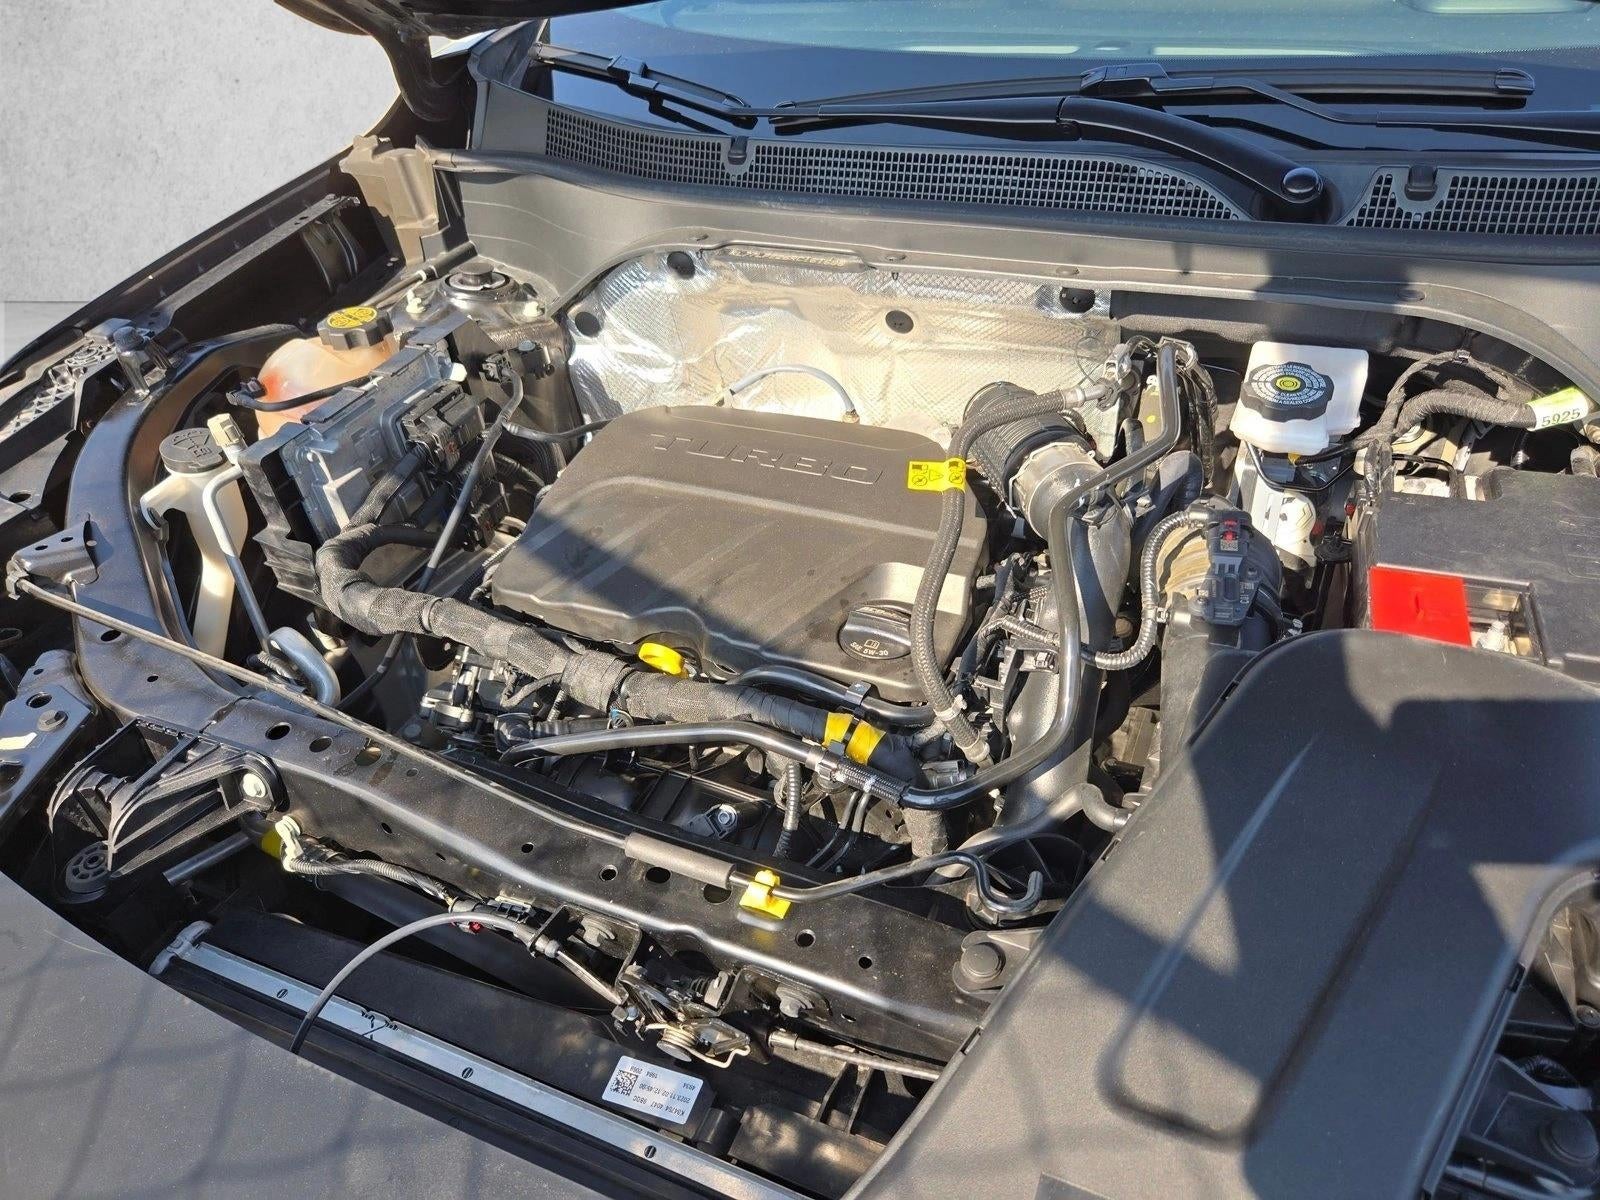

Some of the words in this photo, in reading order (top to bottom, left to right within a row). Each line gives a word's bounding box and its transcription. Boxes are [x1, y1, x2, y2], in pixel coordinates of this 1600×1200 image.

[1541, 408, 1581, 427] 5925
[651, 434, 883, 485] TURBO
[850, 641, 863, 651] SAE
[863, 648, 889, 656] 5W-30
